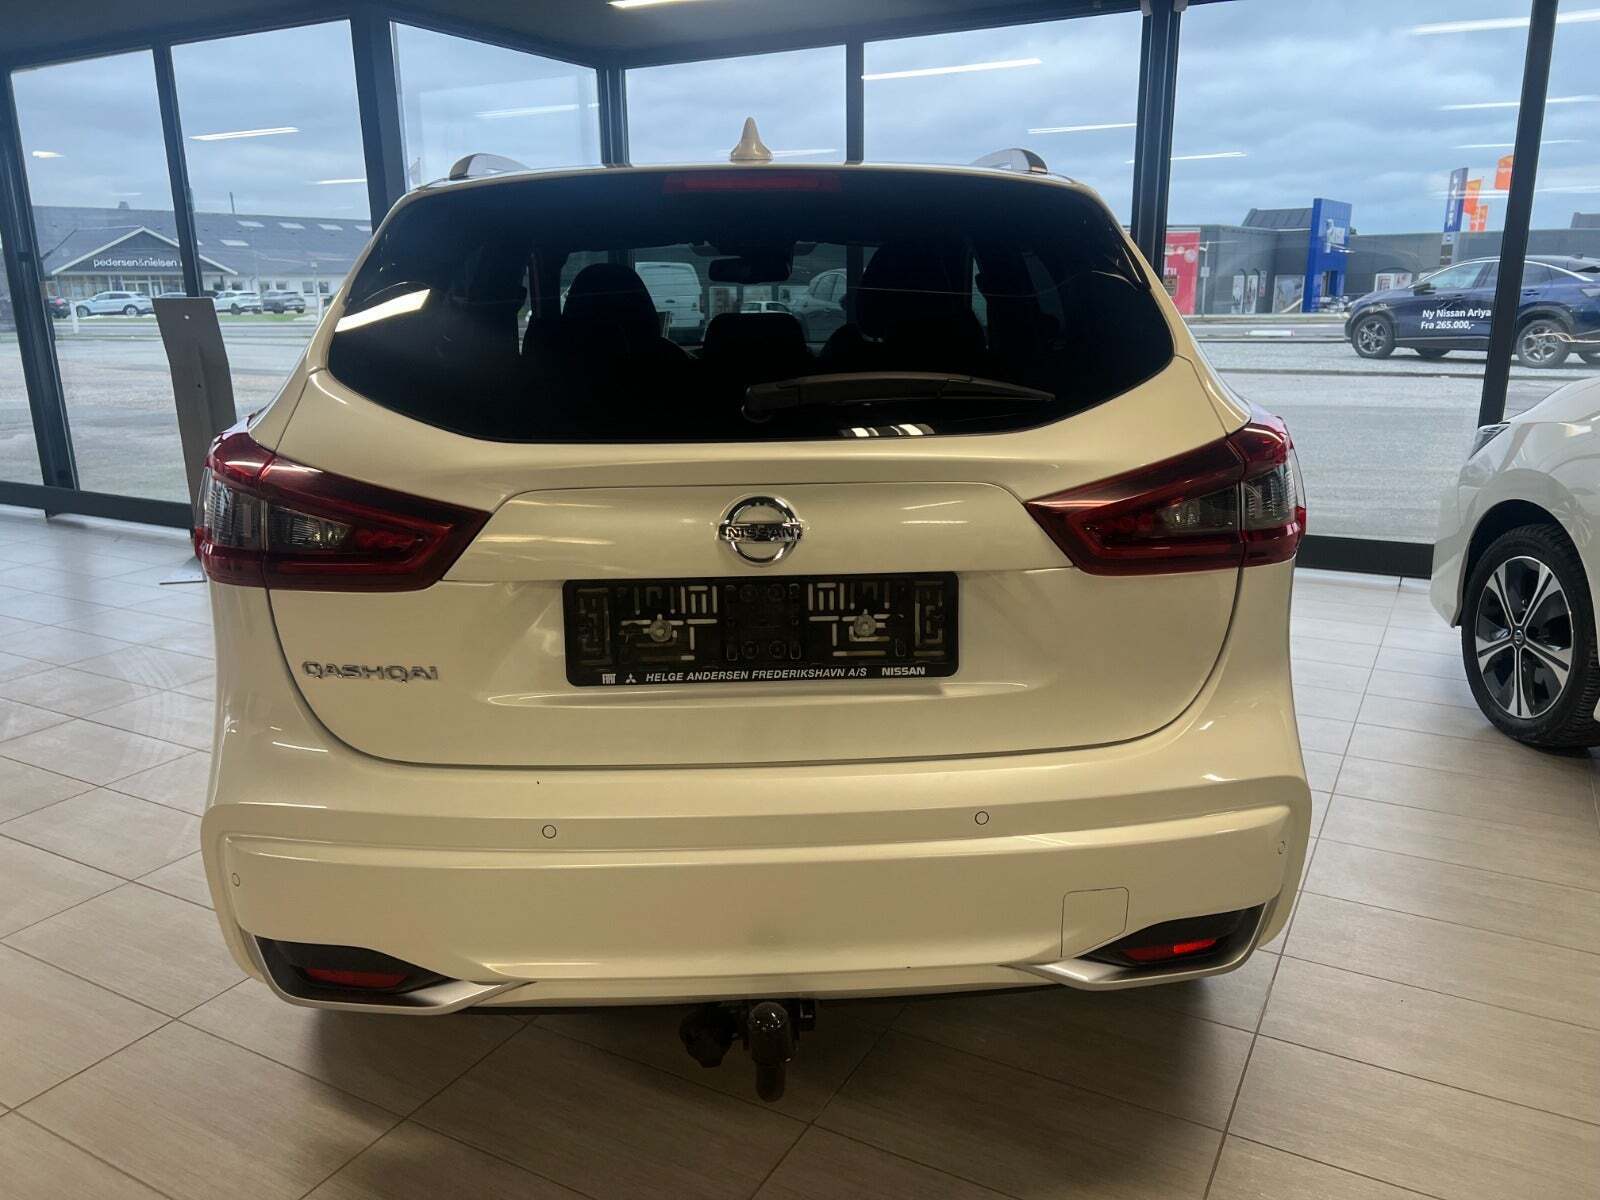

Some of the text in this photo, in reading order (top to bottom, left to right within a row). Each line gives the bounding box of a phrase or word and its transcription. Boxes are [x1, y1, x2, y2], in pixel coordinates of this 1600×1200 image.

[1423, 308, 1492, 319] Ny Nissan Ariya
[1421, 321, 1475, 330] Fra 265.000,-
[727, 526, 796, 540] NISSAN
[302, 660, 439, 683] QASHQAI
[645, 667, 868, 682] HELGE ANDERSEN FREDERIKSHAVN A/S
[881, 666, 926, 677] NISSAN
